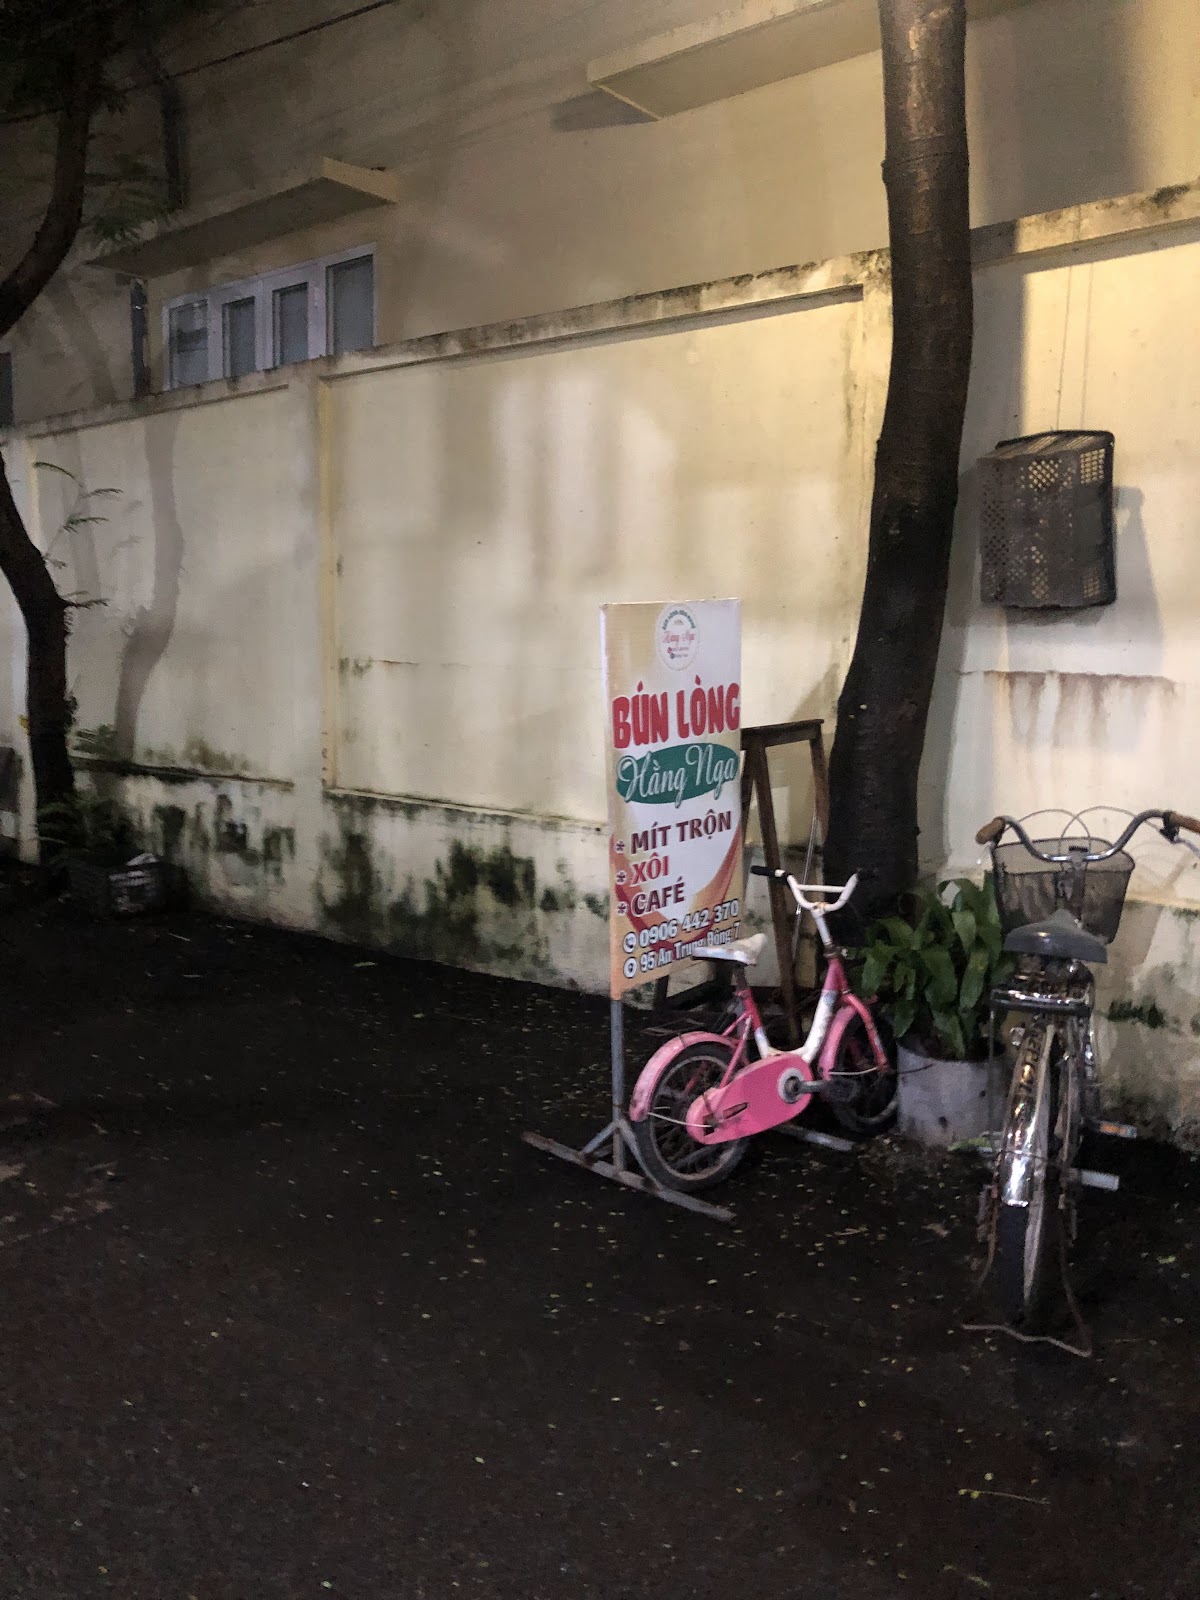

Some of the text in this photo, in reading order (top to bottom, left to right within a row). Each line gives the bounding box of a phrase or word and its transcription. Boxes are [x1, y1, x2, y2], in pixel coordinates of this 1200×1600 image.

[612, 674, 740, 749] BÚN LÒNG
[617, 744, 735, 808] Hằng Nga
[631, 808, 731, 854] MÍT TRỘN
[631, 852, 668, 885] XÔI
[632, 876, 685, 914] CAFÉ
[639, 899, 739, 948] 0906 442 370
[640, 950, 656, 973] 95
[658, 947, 672, 966] An
